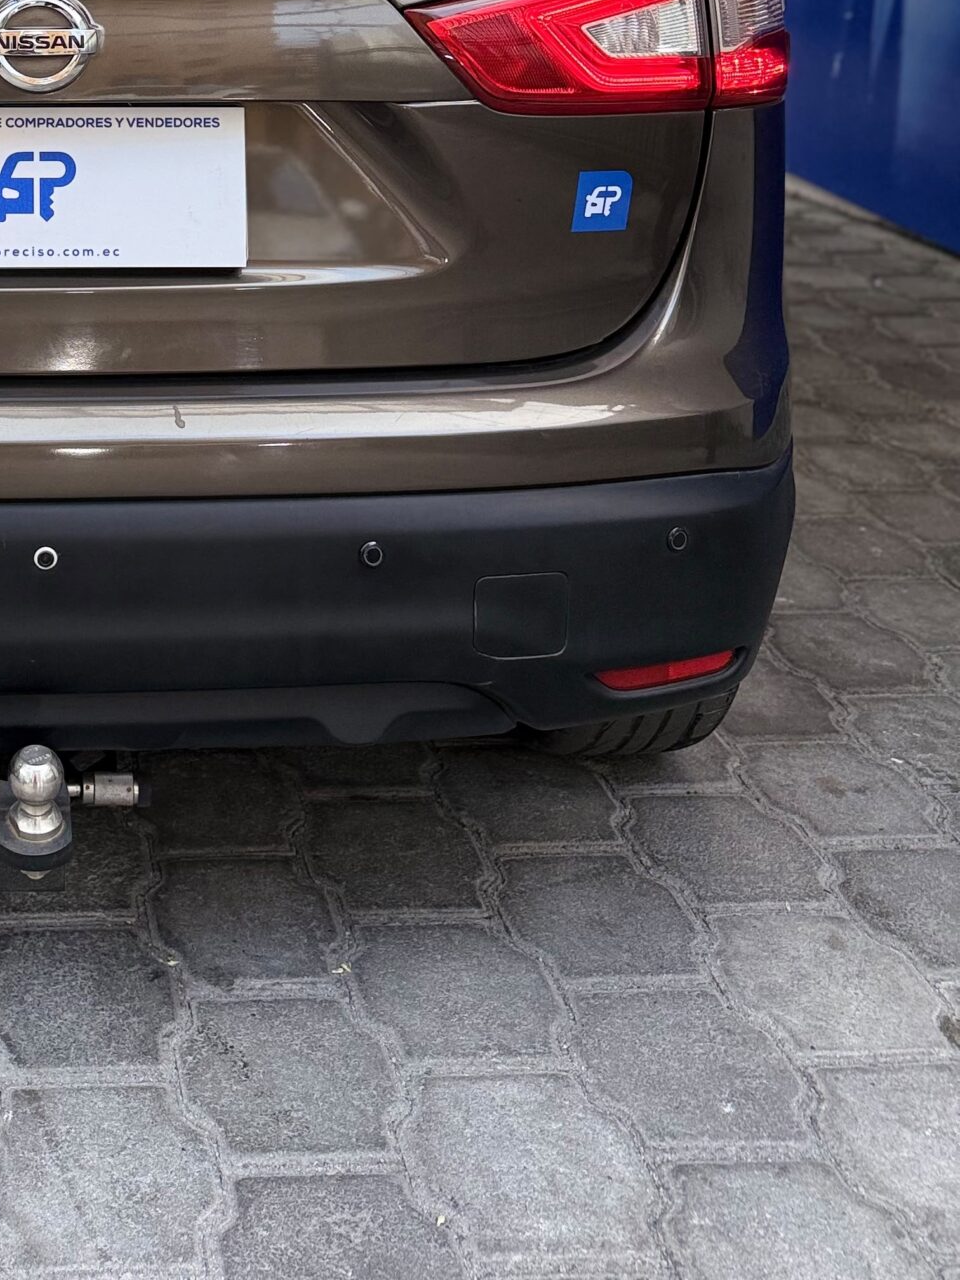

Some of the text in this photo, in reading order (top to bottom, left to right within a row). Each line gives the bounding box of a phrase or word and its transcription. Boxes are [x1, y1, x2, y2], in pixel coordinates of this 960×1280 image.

[5, 117, 112, 129] COMPRADORES
[115, 117, 125, 129] Y
[126, 117, 221, 129] VENDEDORES
